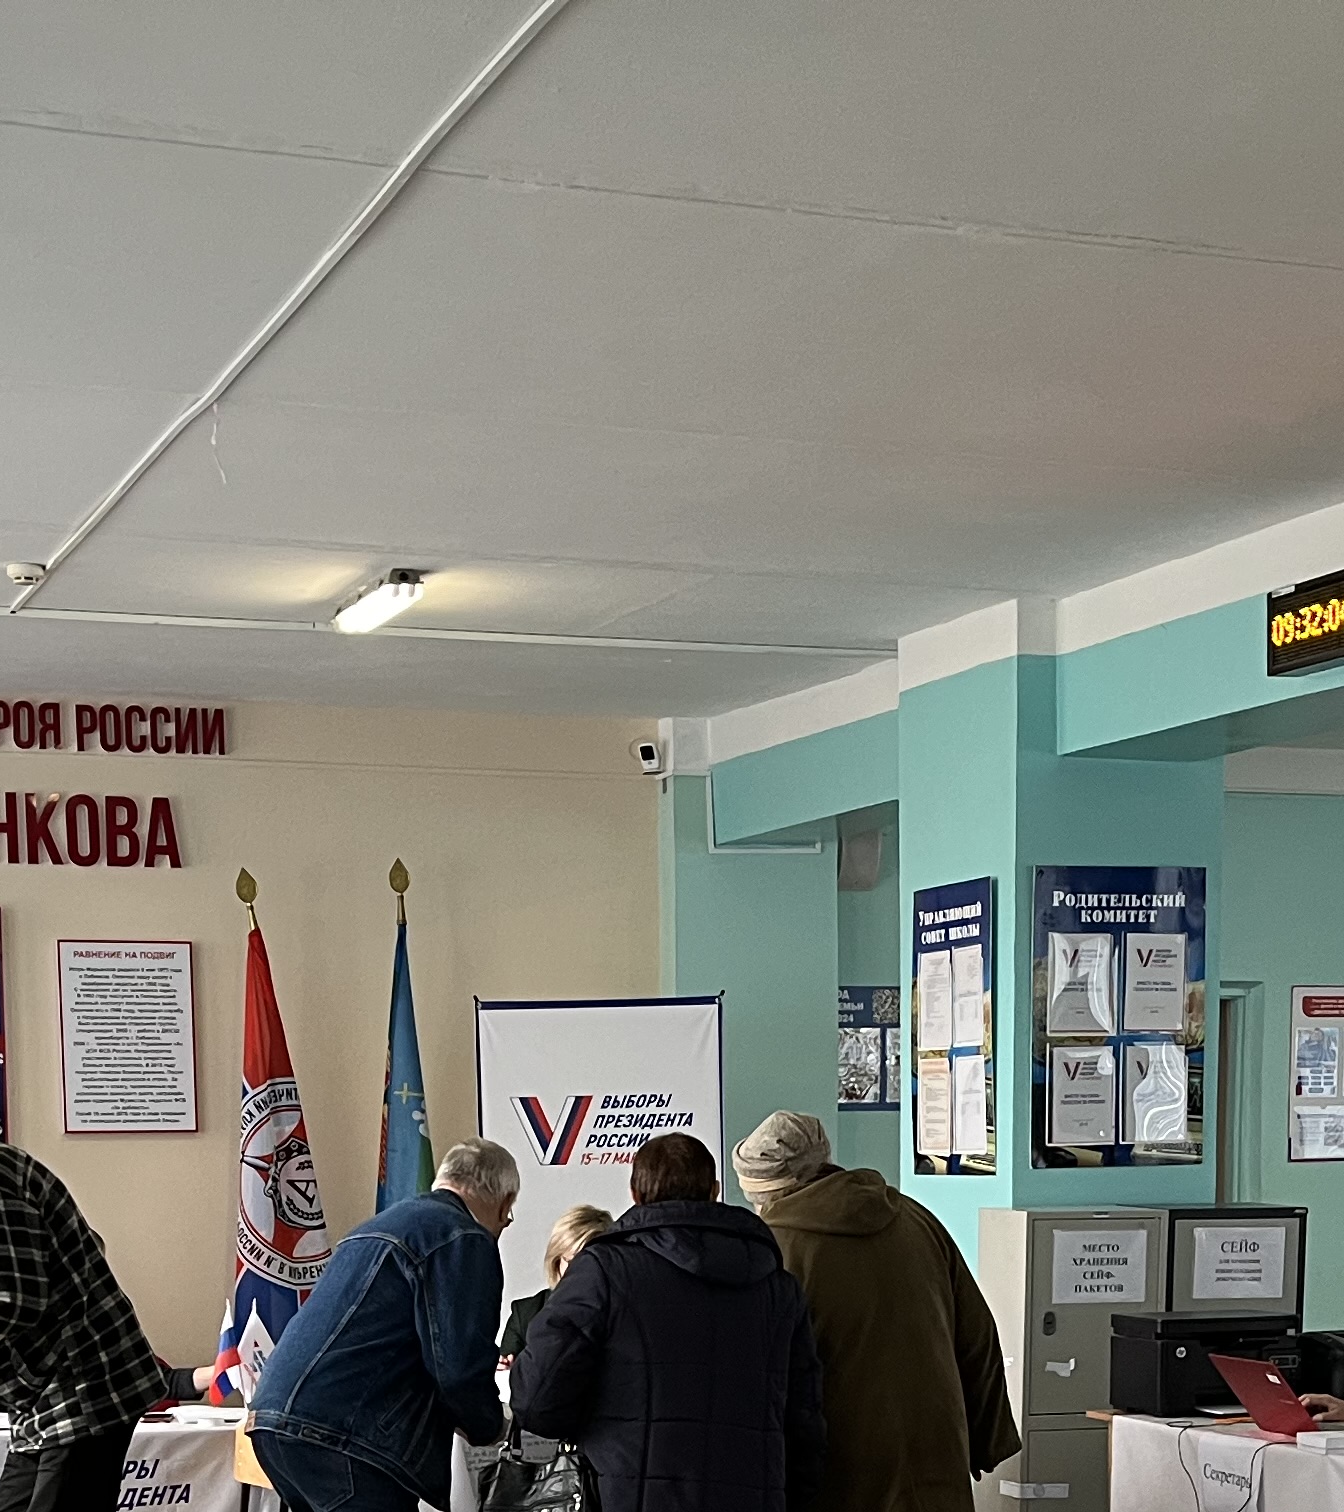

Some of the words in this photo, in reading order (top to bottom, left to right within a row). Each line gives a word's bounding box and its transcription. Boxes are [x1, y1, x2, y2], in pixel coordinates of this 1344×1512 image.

[75, 704, 227, 755] РОССИИ
[1081, 910, 1157, 922] КОМИТЕТ
[600, 1093, 672, 1109] ВЫБОРЫ
[593, 1112, 693, 1129] ПРЕЗИДЕНТА
[585, 1133, 651, 1148] РОССИИ
[1082, 1244, 1120, 1252] МЕСТО
[1220, 1238, 1260, 1253] СЕЙФ
[1072, 1257, 1128, 1266] ХРАНЕНИЯ
[1074, 1284, 1124, 1293] ПАКЕТОВ
[1203, 1463, 1251, 1492] Секретарь
[117, 1484, 191, 1511] ДЕНТА
